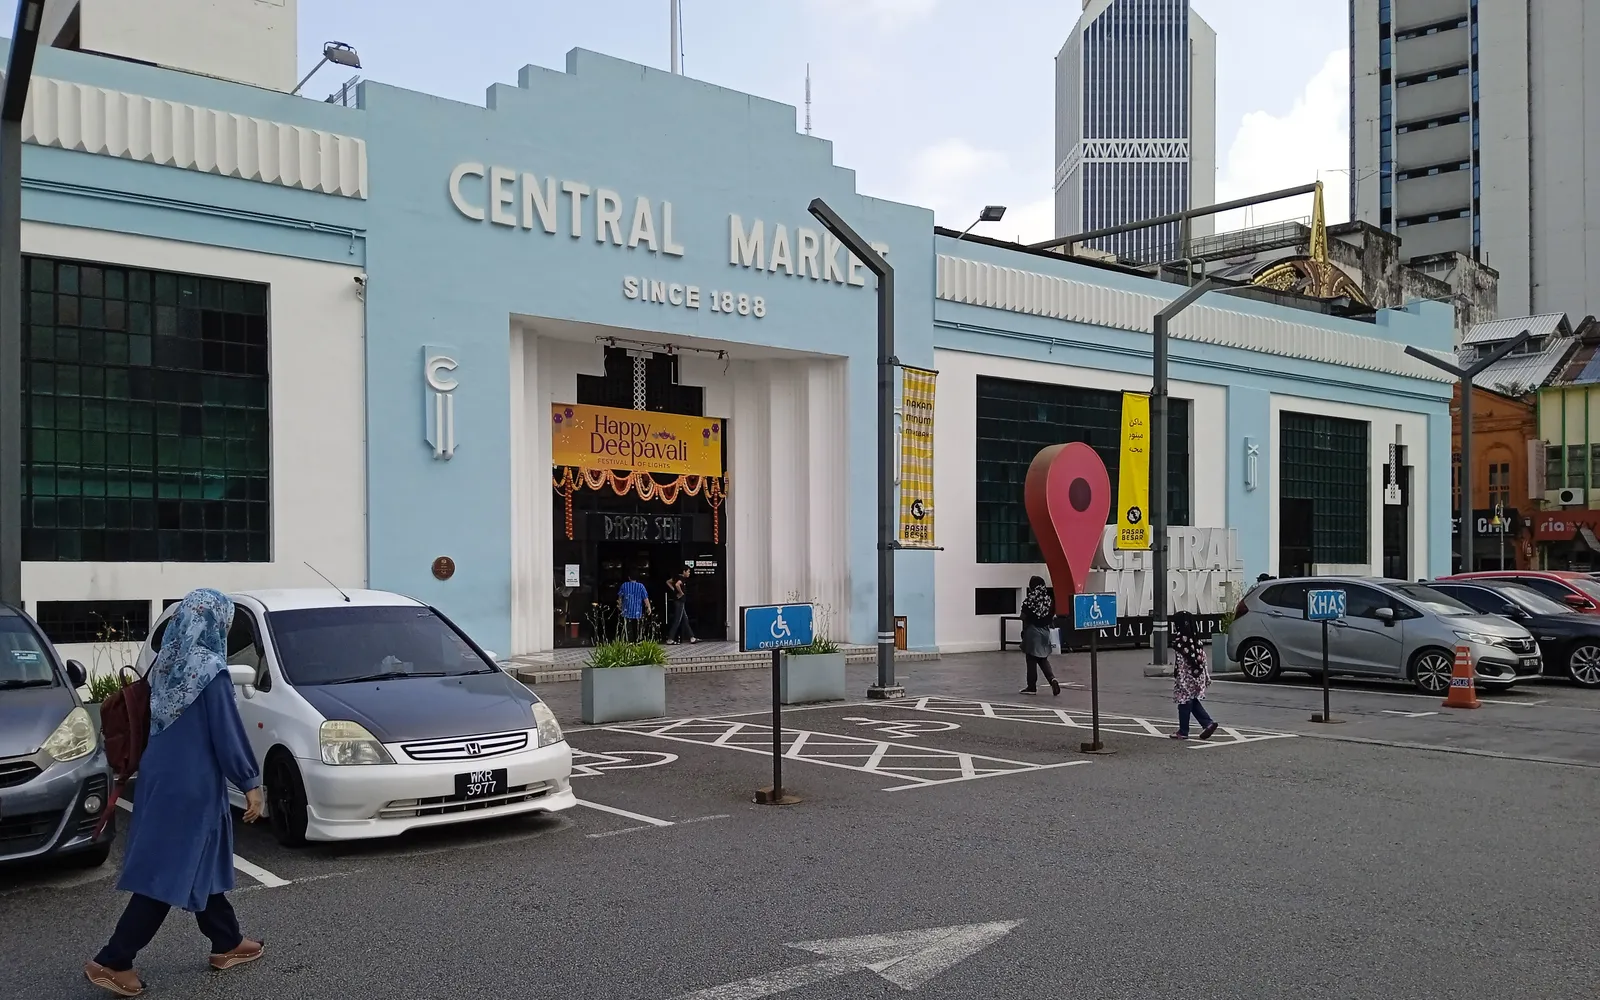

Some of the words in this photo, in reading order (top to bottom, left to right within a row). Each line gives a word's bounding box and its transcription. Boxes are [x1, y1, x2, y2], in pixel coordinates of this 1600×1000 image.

[449, 162, 684, 257] CENTRAL
[622, 276, 700, 308] SINCE
[710, 290, 766, 319] 1888
[595, 414, 651, 442] Happy
[590, 432, 688, 467] Deepavali
[597, 457, 628, 466] FESTIVAL
[1477, 517, 1511, 533] CIY
[1540, 517, 1565, 532] ria
[1103, 525, 1244, 571] CTRAL
[1310, 594, 1345, 615] KHAS
[1099, 622, 1147, 638] KUAL
[1170, 620, 1223, 635] LMPU
[759, 641, 774, 649] OKU
[775, 638, 802, 648] SAHAJA
[1452, 679, 1469, 687] POLIS
[470, 770, 493, 784] WKR
[466, 780, 497, 796] 3977
